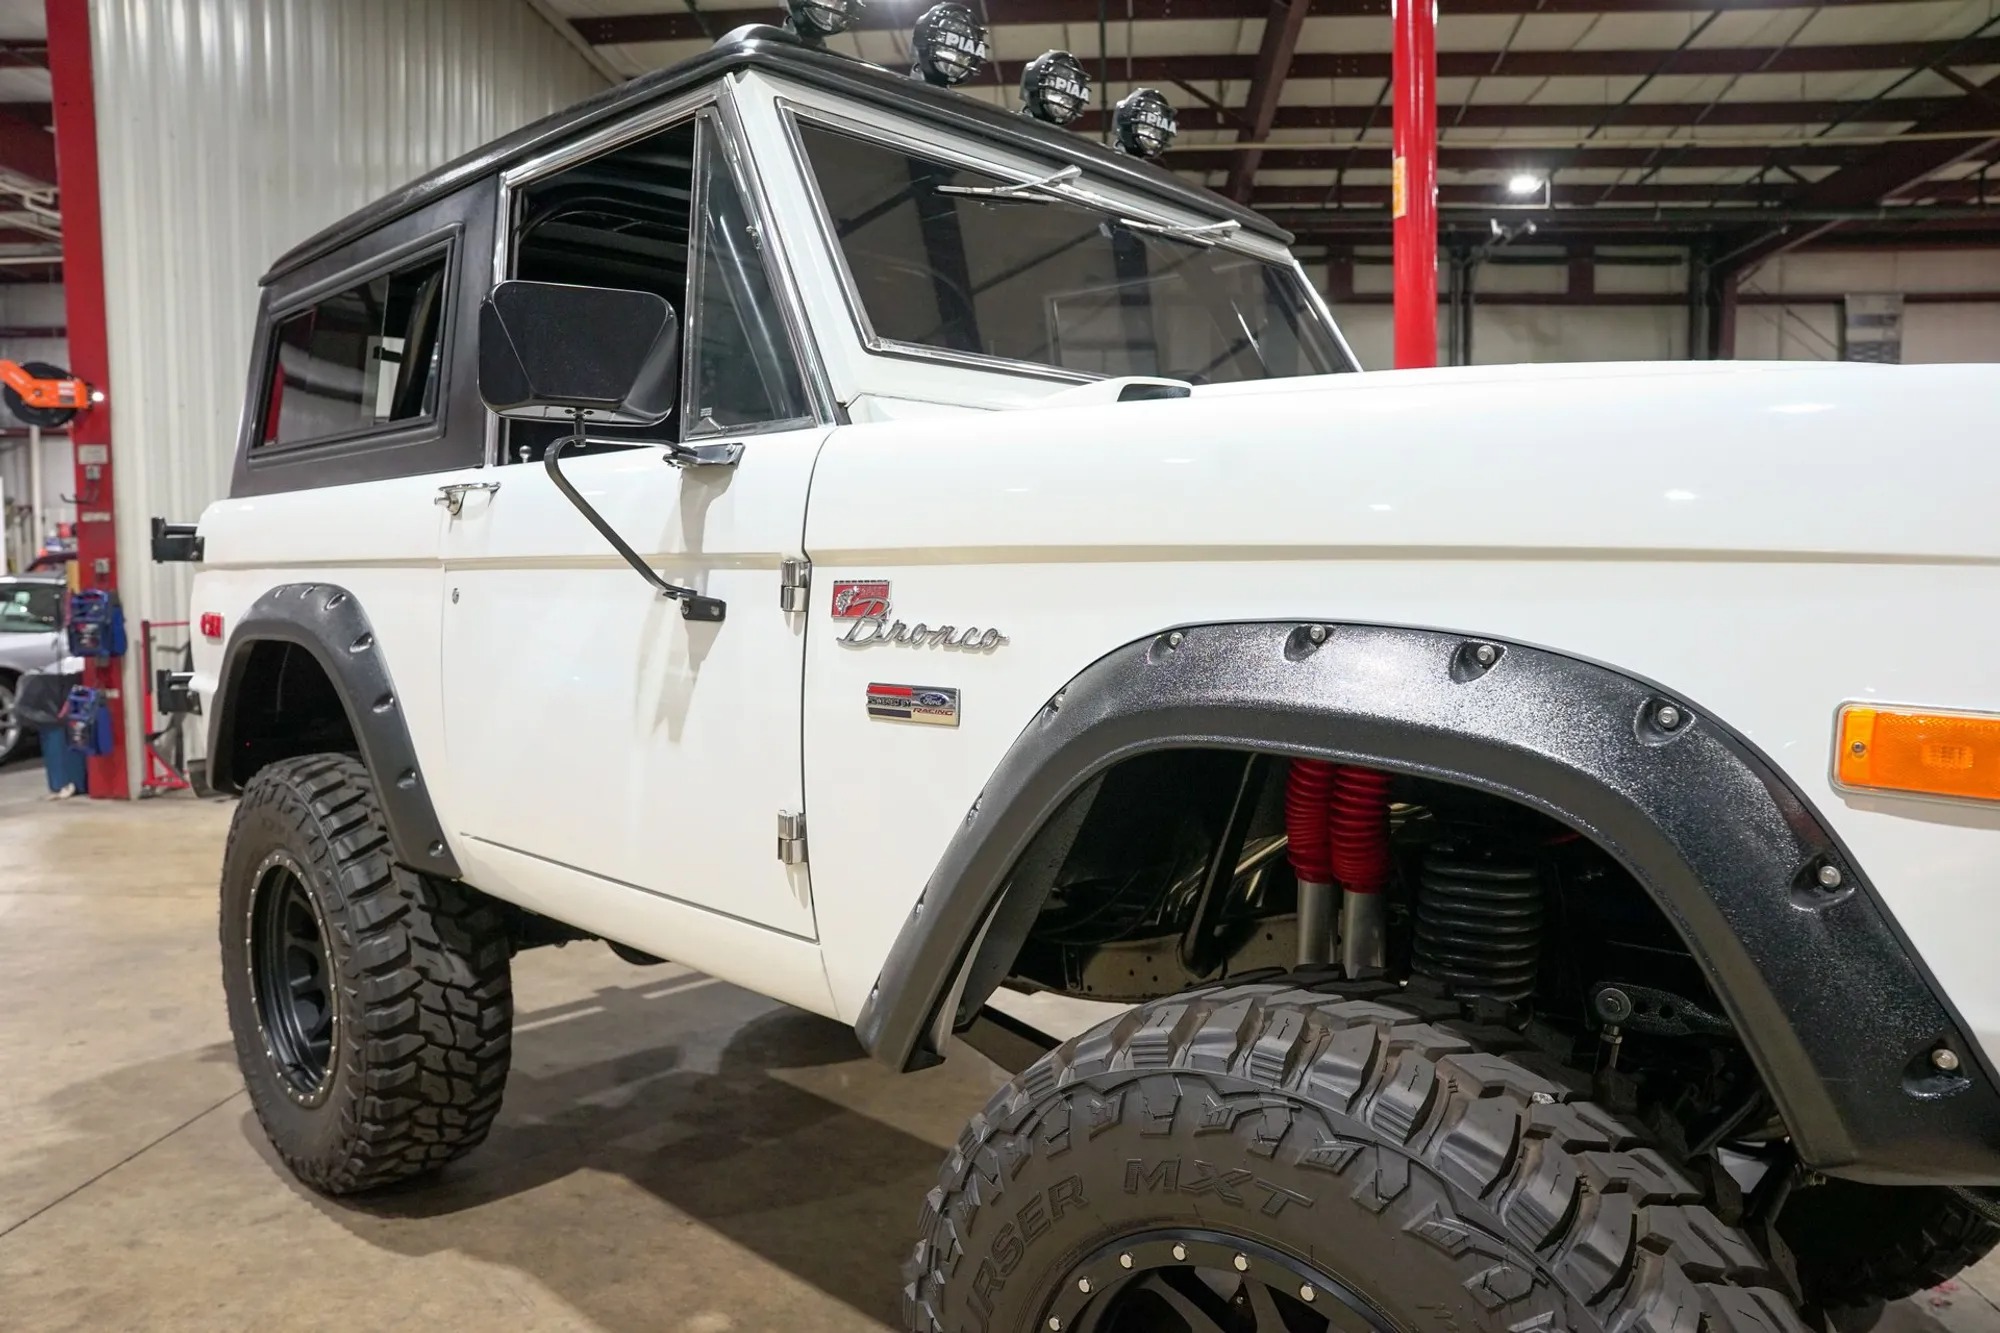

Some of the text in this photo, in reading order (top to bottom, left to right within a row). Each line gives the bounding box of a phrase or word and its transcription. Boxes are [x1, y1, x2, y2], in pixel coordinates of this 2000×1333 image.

[945, 31, 986, 59] PIAA
[1055, 76, 1089, 101] PIAA
[1146, 112, 1177, 136] PIAA
[836, 597, 1008, 648] Bronco
[912, 707, 954, 716] RACING
[922, 694, 945, 706] Ford
[1123, 1158, 1313, 1217] MXT
